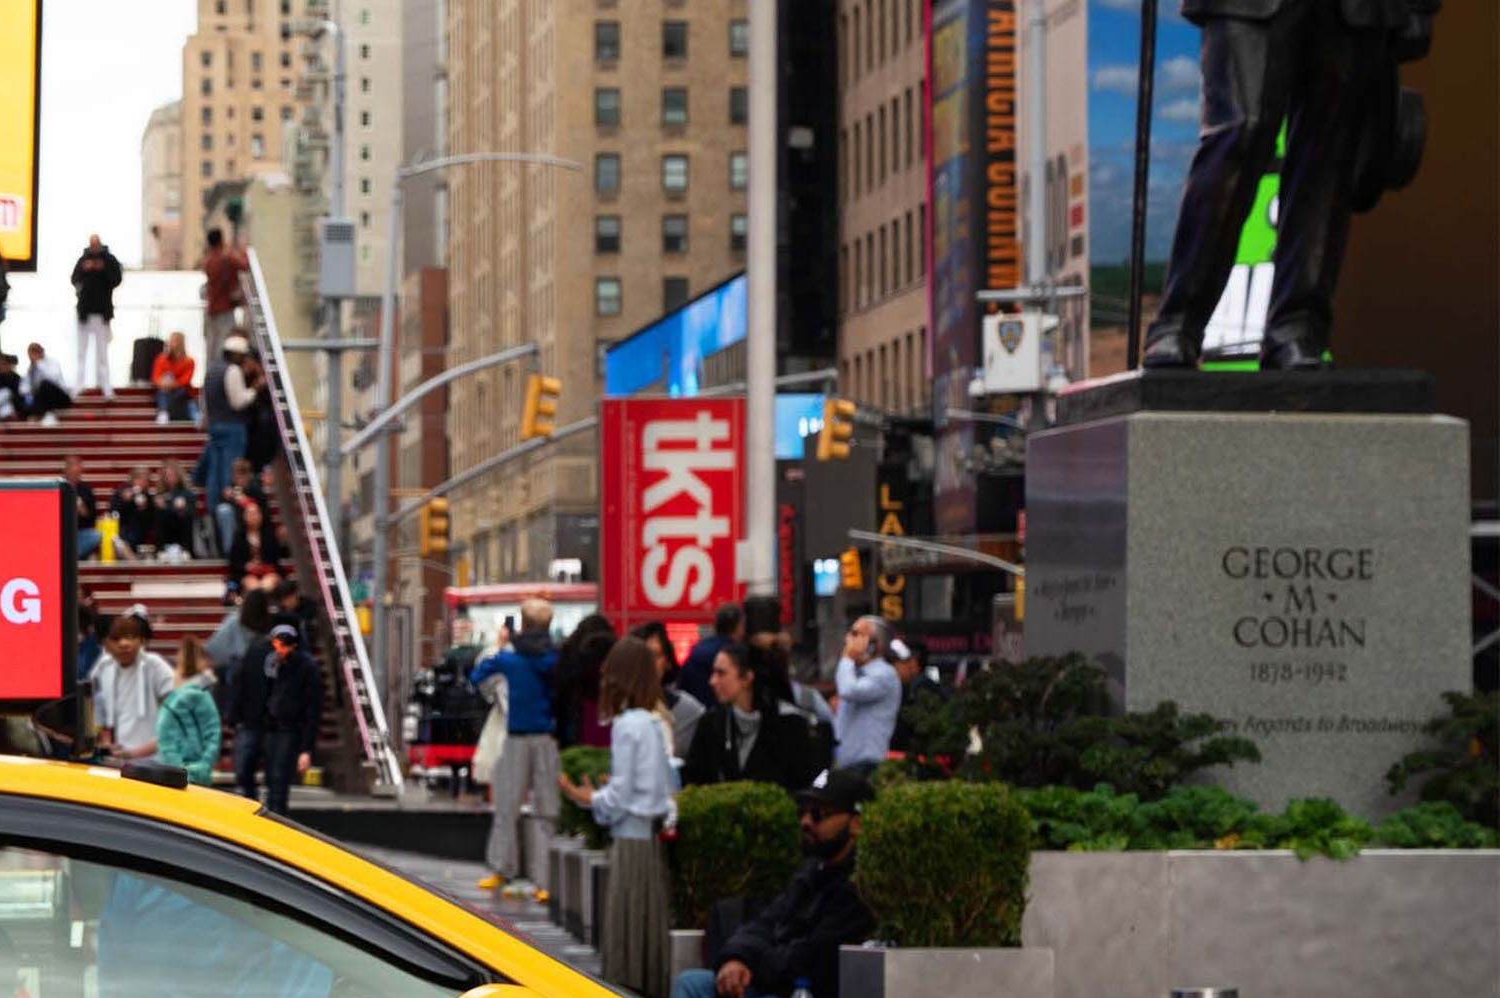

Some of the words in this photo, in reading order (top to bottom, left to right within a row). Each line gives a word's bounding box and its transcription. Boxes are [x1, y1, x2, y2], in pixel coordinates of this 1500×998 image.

[641, 411, 736, 608] tkts
[1222, 546, 1375, 581] GEORGE
[1233, 616, 1367, 648] COHAN
[1251, 661, 1348, 686] 1878-1942
